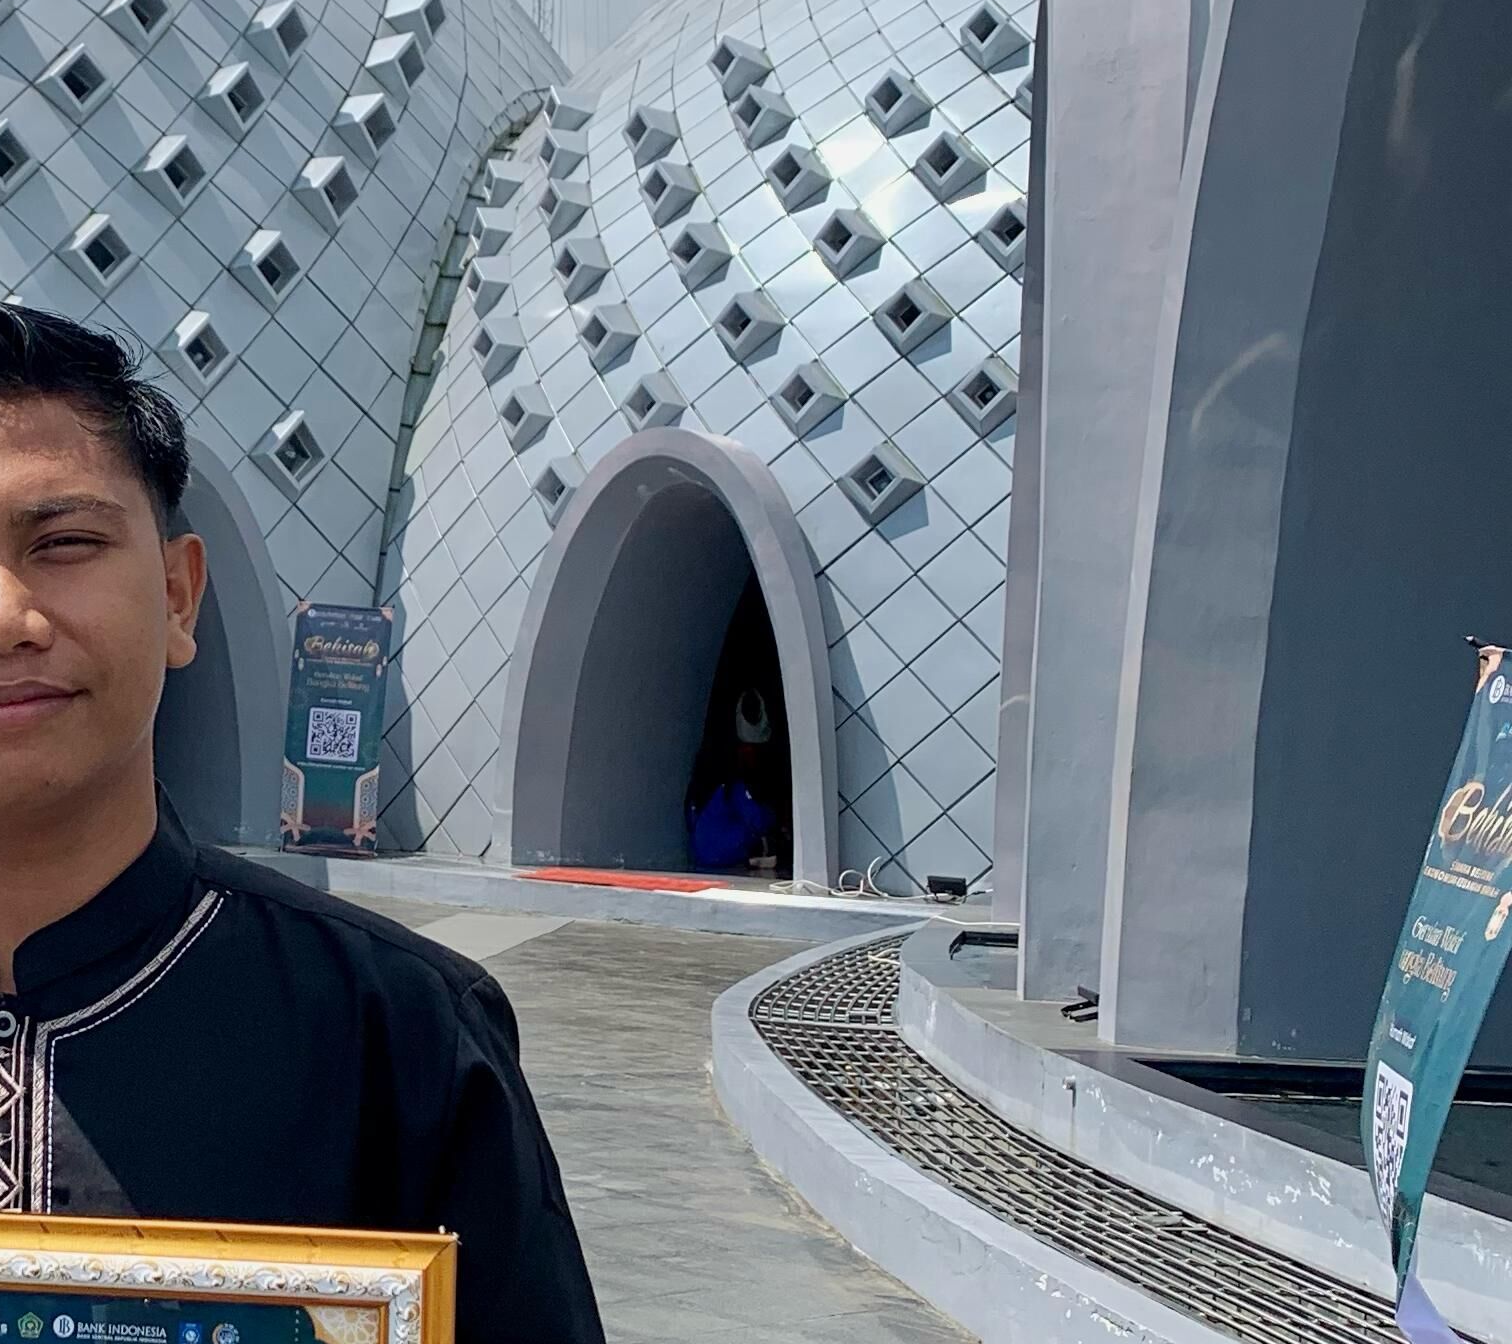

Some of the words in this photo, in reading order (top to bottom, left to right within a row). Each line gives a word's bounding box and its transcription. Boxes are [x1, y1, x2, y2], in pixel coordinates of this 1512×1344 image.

[1441, 777, 1512, 856] Bekis
[77, 1321, 105, 1334] BANK
[108, 1323, 167, 1338] INDONESIA
